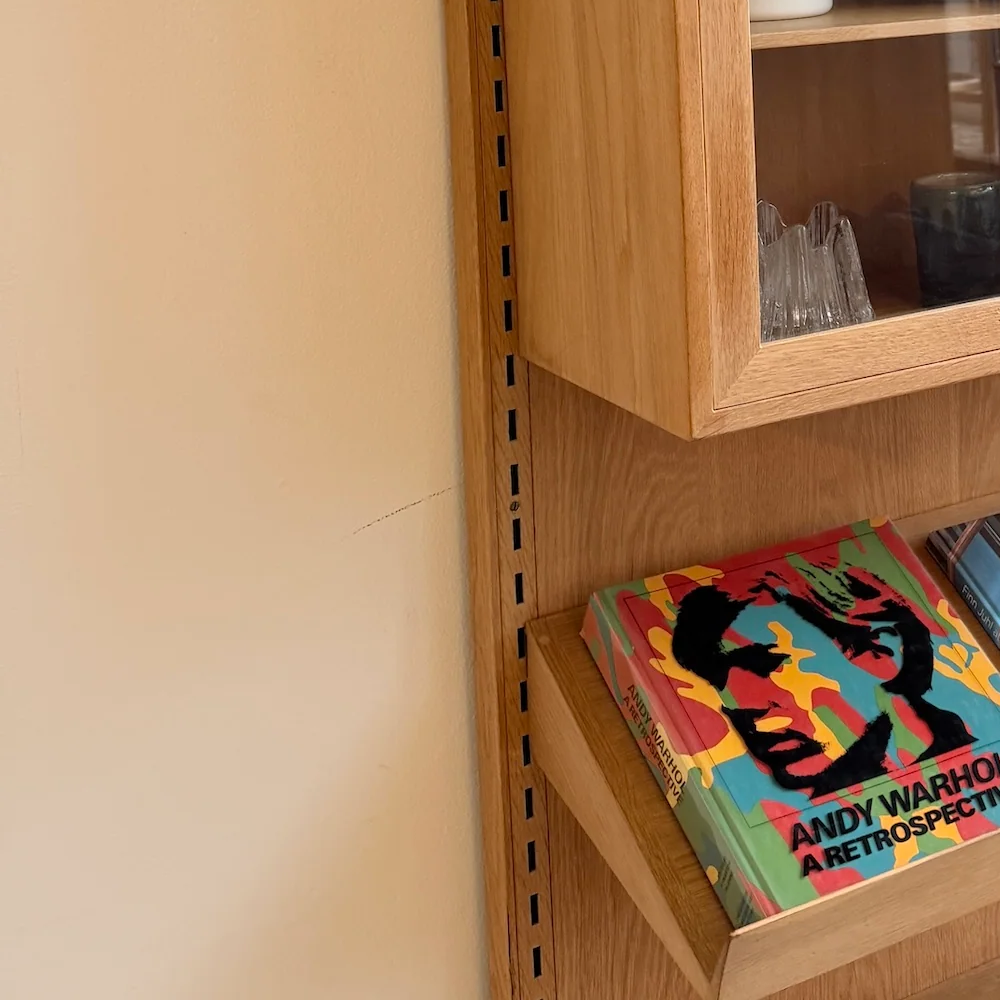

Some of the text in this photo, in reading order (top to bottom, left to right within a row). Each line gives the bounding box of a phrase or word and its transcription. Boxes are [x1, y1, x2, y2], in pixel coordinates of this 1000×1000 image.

[962, 584, 978, 609] Finn
[977, 608, 994, 629] Juhl
[623, 695, 683, 803] A RETROSPECTIVE
[627, 684, 687, 796] ANDY WARHOL
[791, 797, 875, 852] ANDY
[802, 852, 825, 878] A
